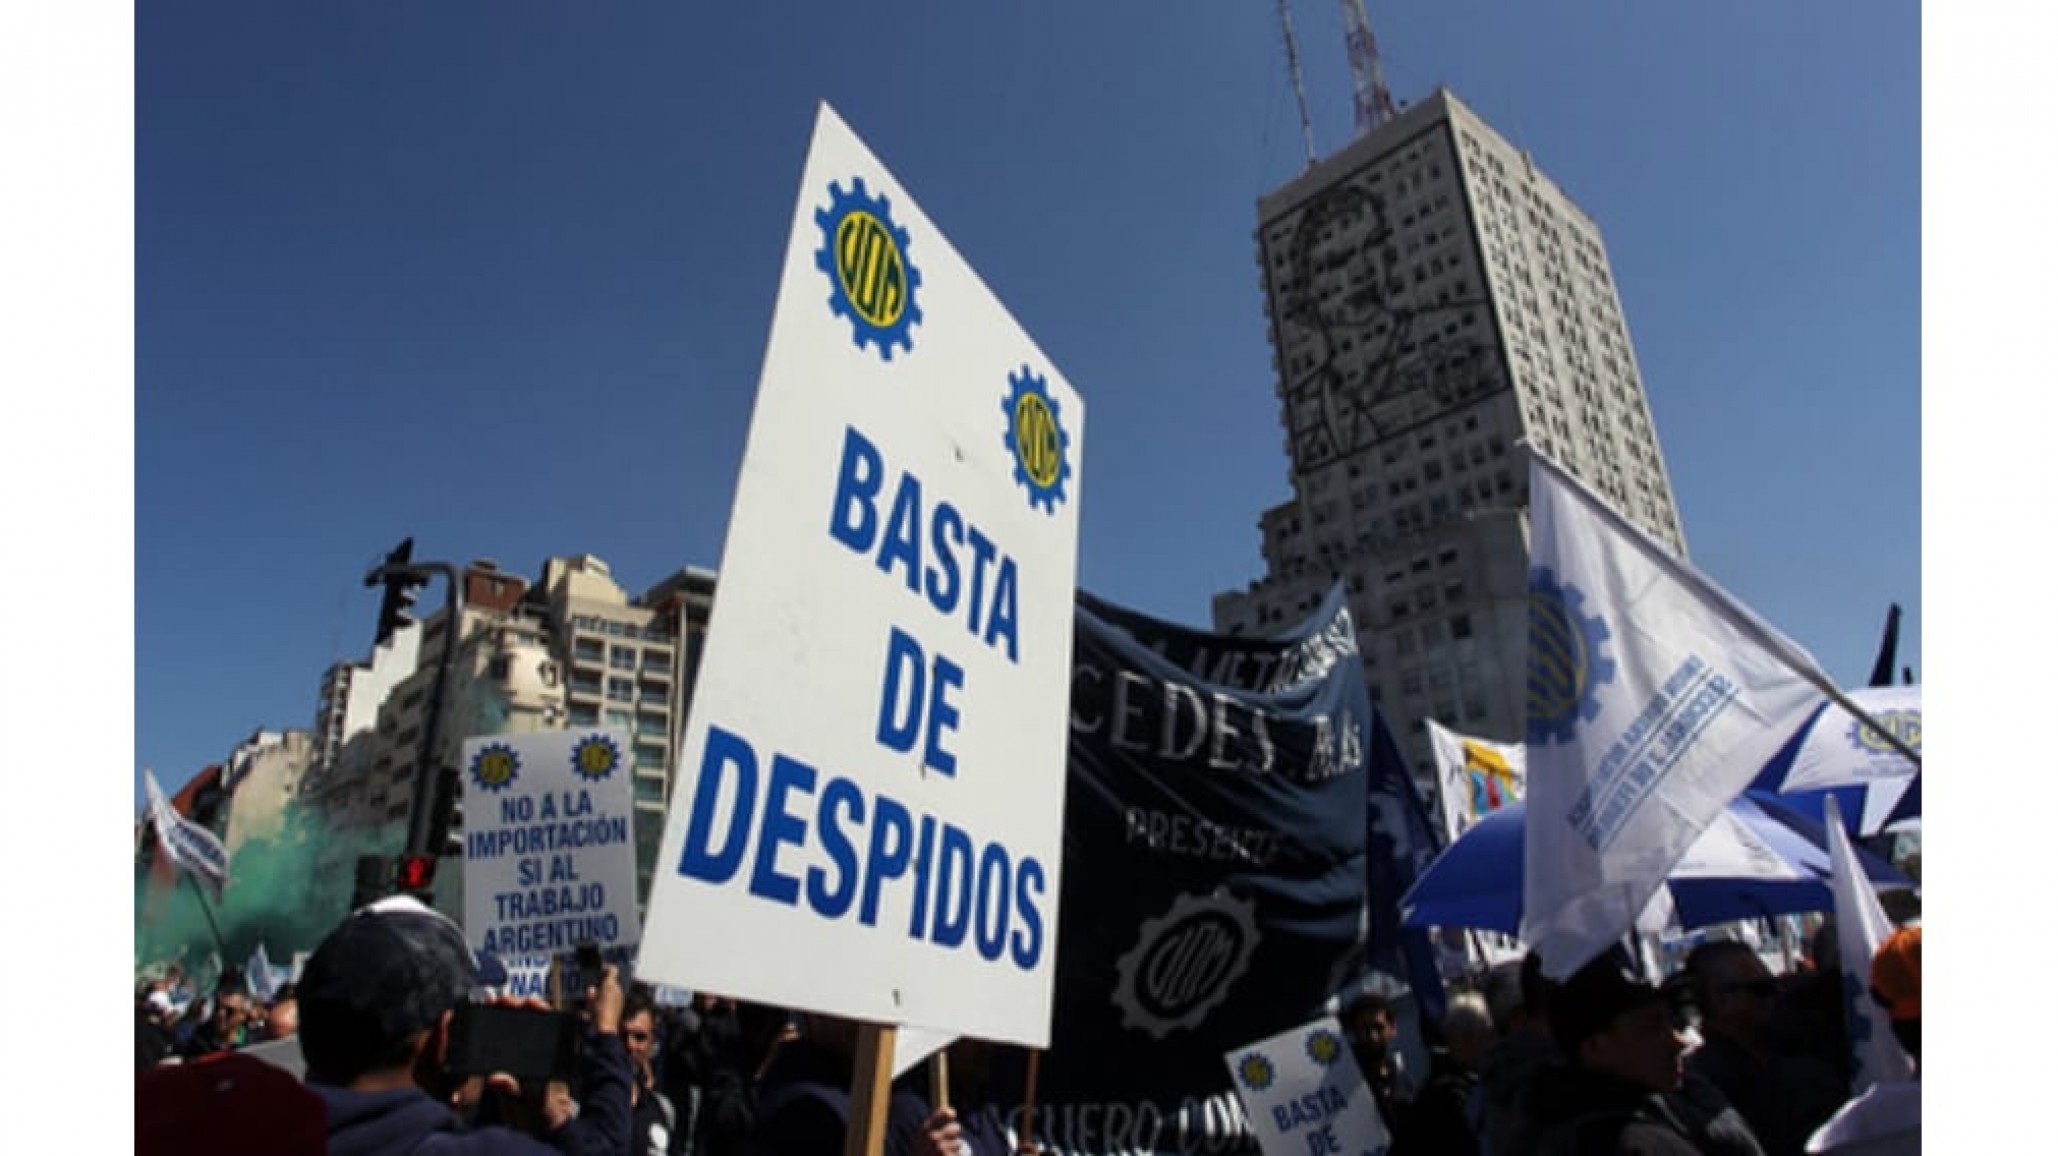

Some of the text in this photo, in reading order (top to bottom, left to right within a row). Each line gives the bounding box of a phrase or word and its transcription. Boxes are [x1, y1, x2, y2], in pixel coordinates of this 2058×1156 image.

[829, 425, 1018, 664] BASTA
[876, 624, 964, 778] DE
[502, 791, 591, 824] NO A LA
[468, 813, 626, 859] IMPORTACIÓN
[677, 724, 1045, 971] DESPIDOS
[518, 854, 578, 886] SI AL
[495, 883, 604, 920] TRABAJO
[484, 913, 618, 953] ARGENTINO
[1272, 1085, 1348, 1132] BASTA
[1306, 1124, 1342, 1156] DE
